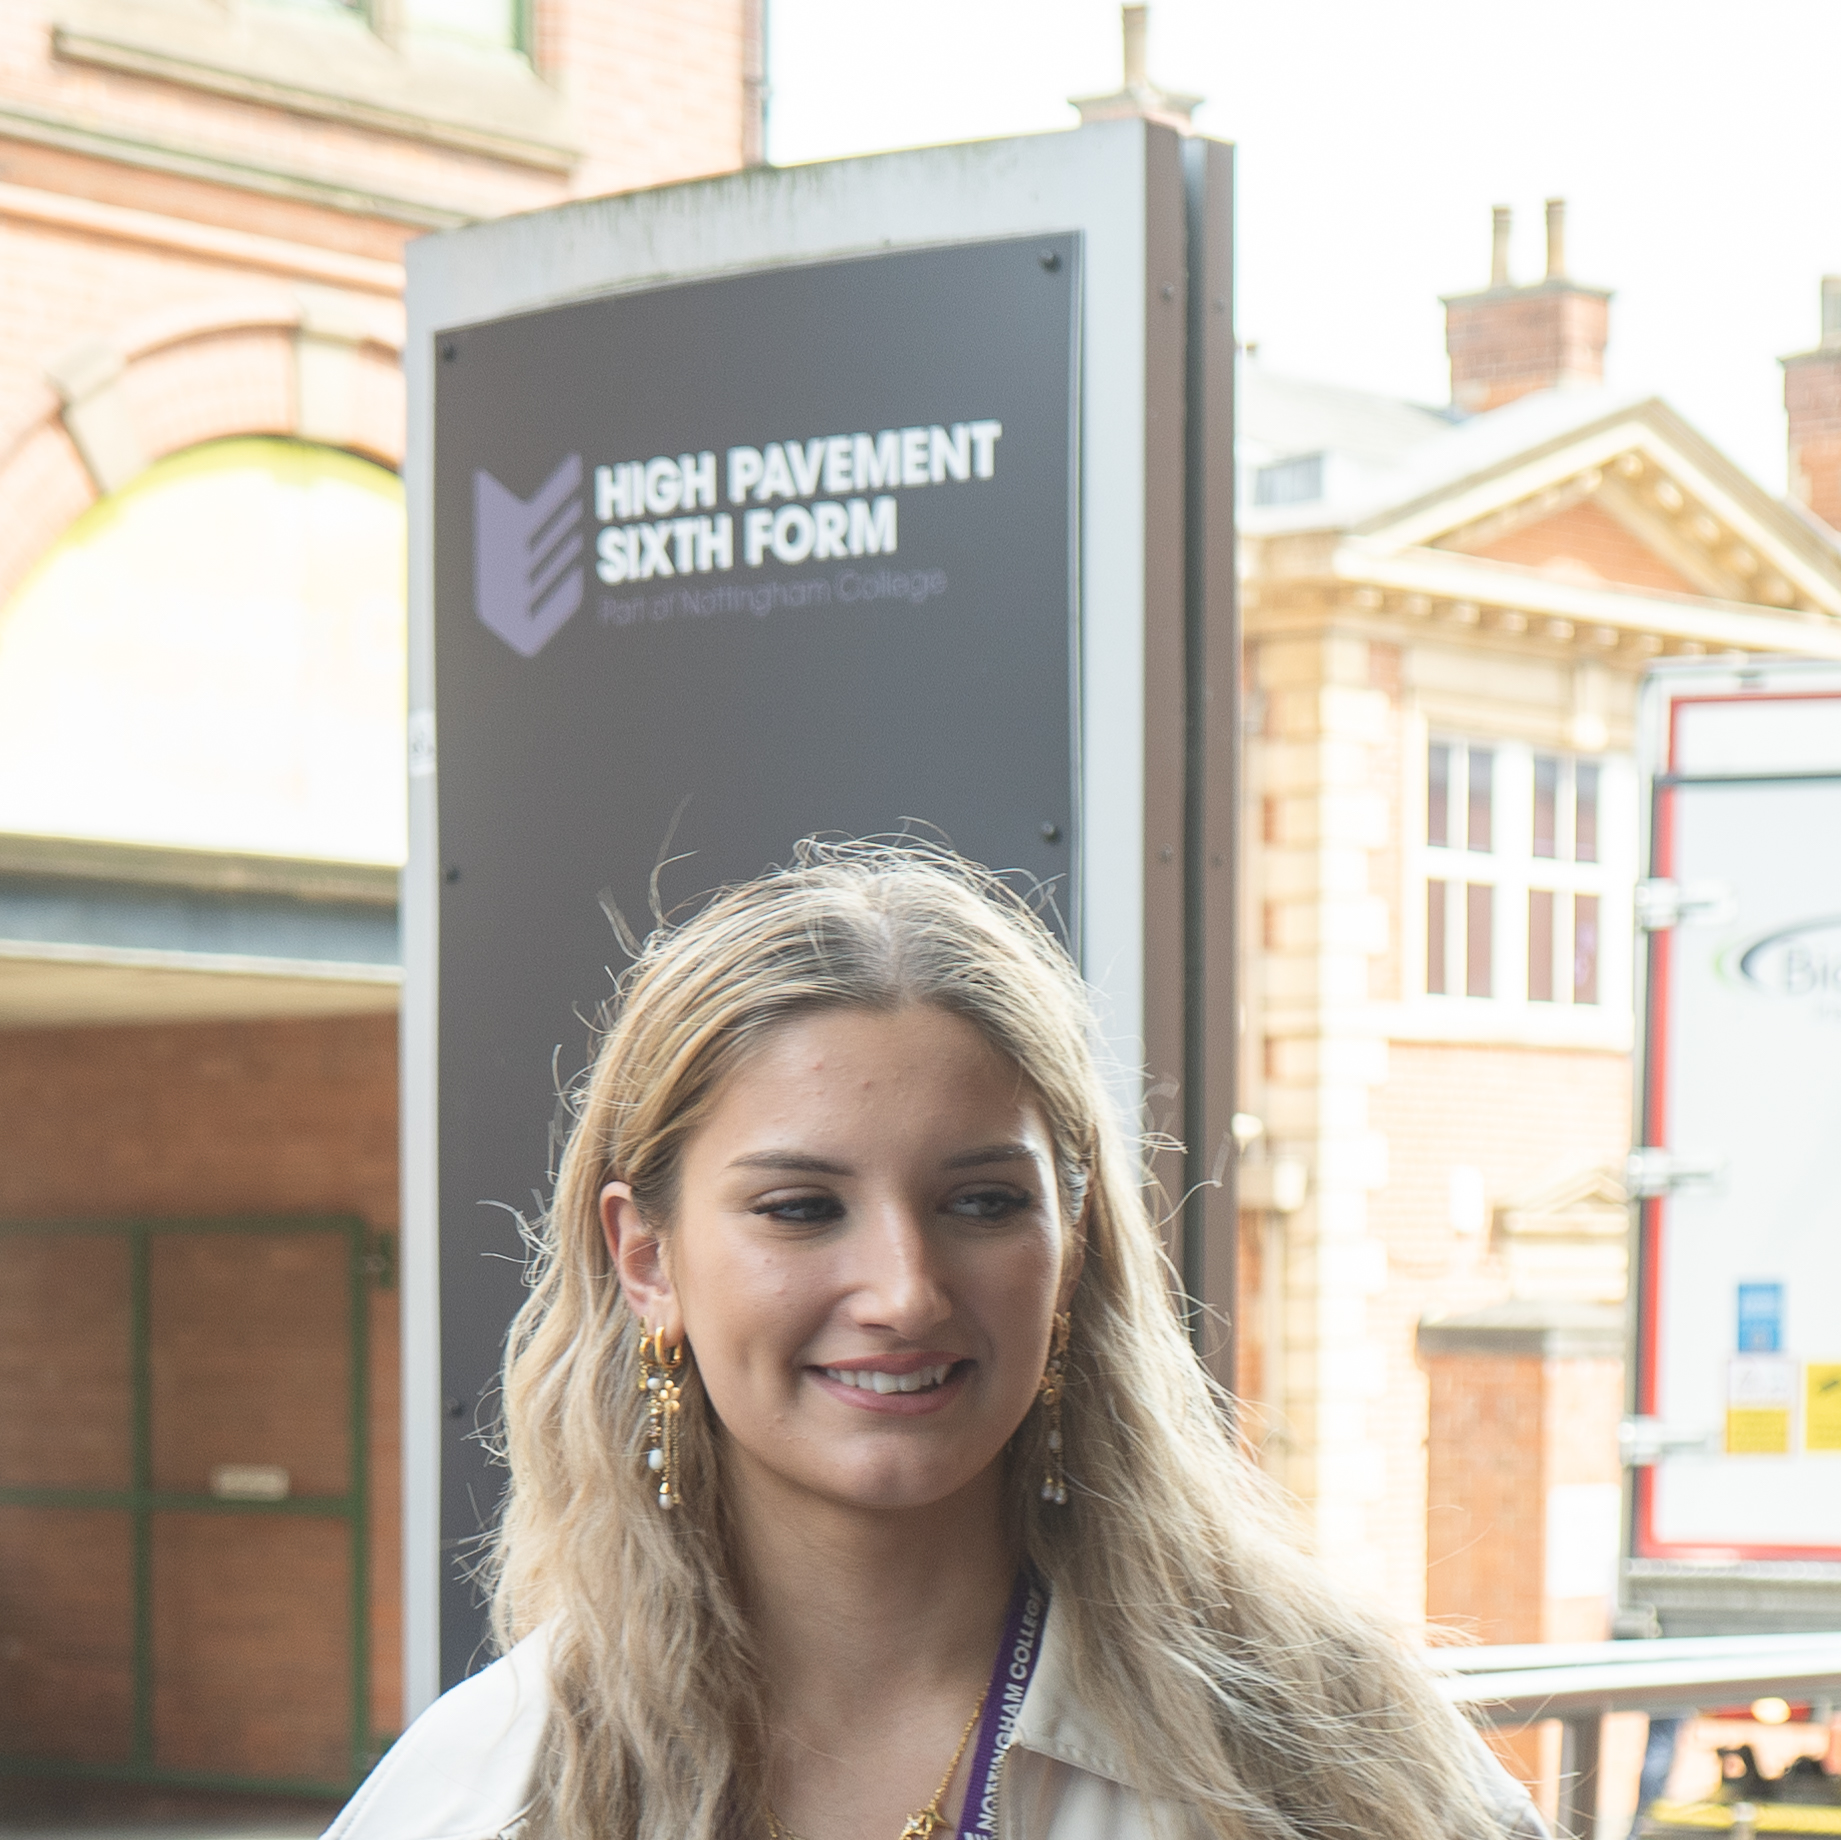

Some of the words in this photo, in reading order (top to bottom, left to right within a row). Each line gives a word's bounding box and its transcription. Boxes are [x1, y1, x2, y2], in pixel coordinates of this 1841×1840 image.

[595, 451, 718, 520] HIGH
[729, 419, 1003, 505] PAVEMENT
[596, 514, 734, 586] SIXTH
[744, 498, 898, 566] FORM
[599, 595, 646, 625] Part
[651, 592, 676, 619] of
[682, 575, 832, 617] Nottingham
[837, 566, 948, 605] College
